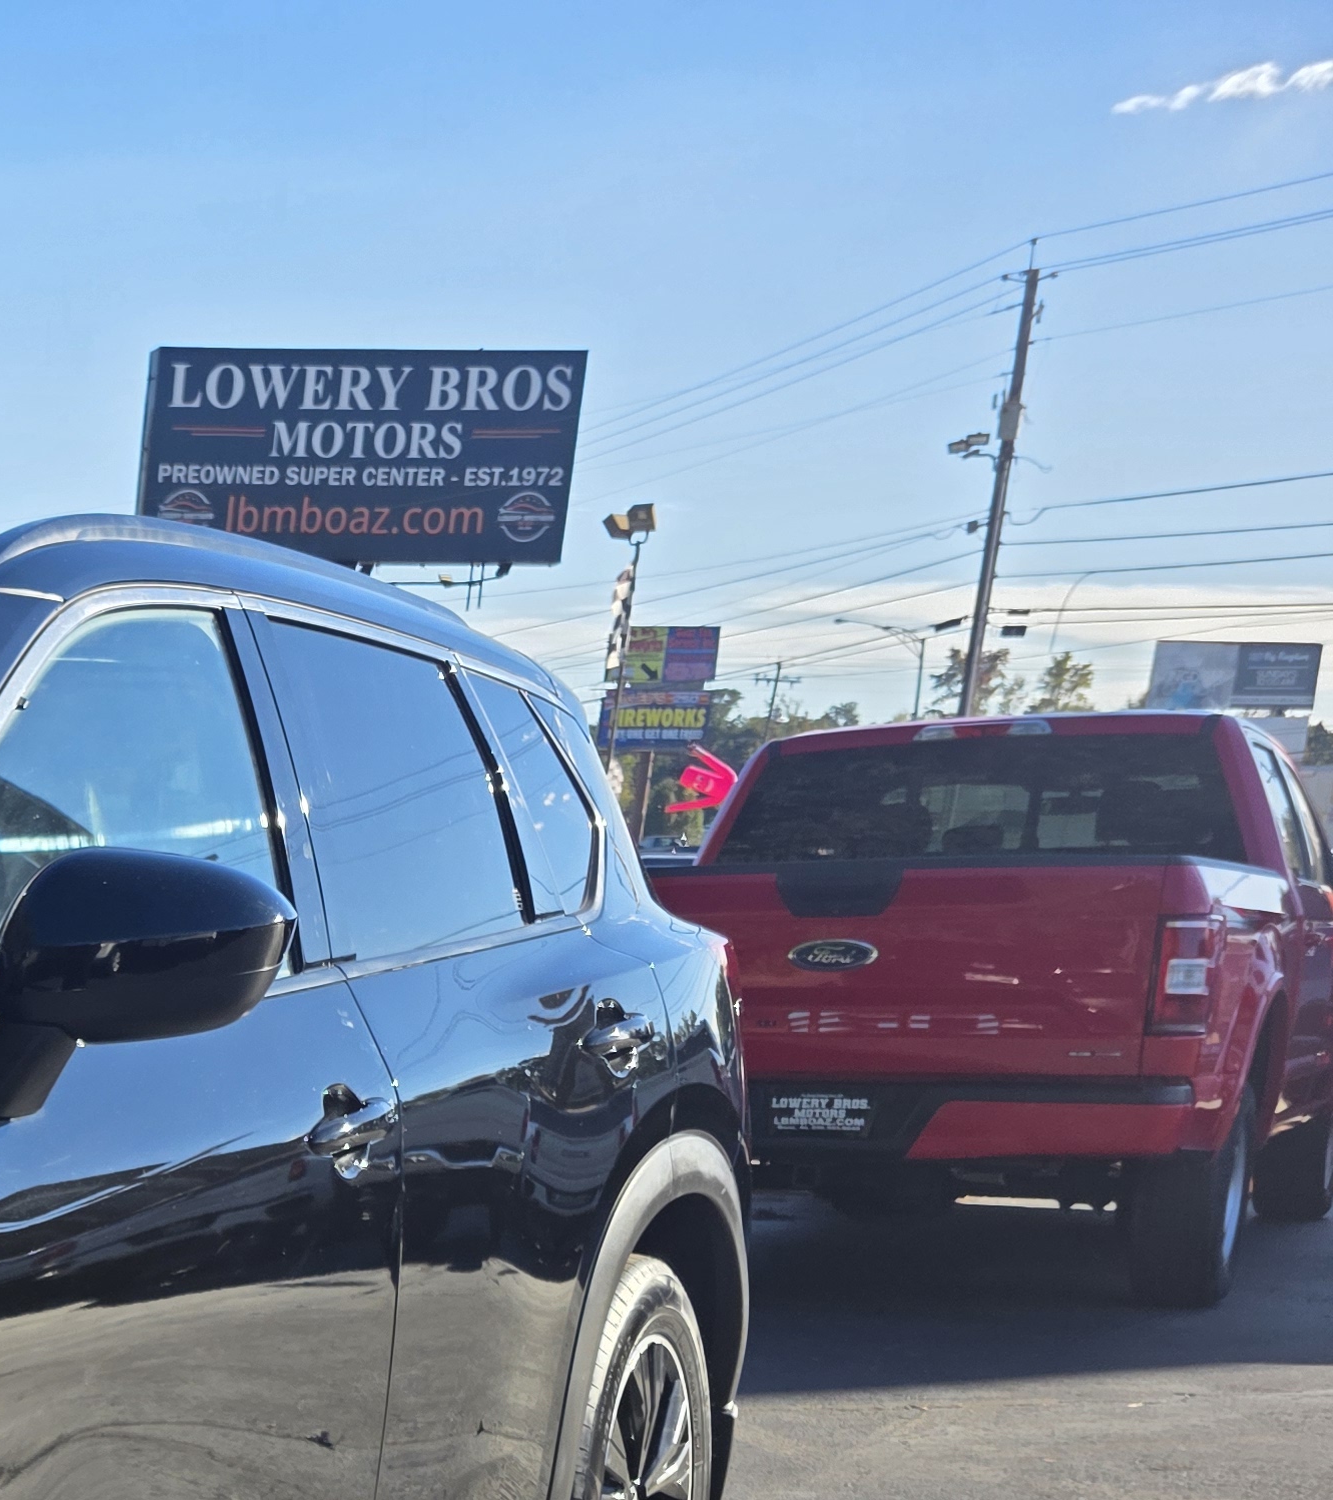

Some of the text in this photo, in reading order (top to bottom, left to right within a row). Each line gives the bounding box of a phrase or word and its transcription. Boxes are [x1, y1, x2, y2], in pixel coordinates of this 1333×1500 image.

[168, 363, 573, 413] LOWERY BROS
[269, 421, 463, 459] MOTORS
[157, 464, 280, 486] PREOWNED
[285, 466, 356, 487] SUPER
[362, 467, 445, 487] CENTER
[464, 467, 564, 487] EST.1972
[225, 494, 483, 535] lbmboaz.com
[610, 708, 706, 728] IREWORKS
[807, 946, 856, 963] Ford
[771, 1097, 829, 1108] LOWERY
[793, 1108, 846, 1118] MOTORS
